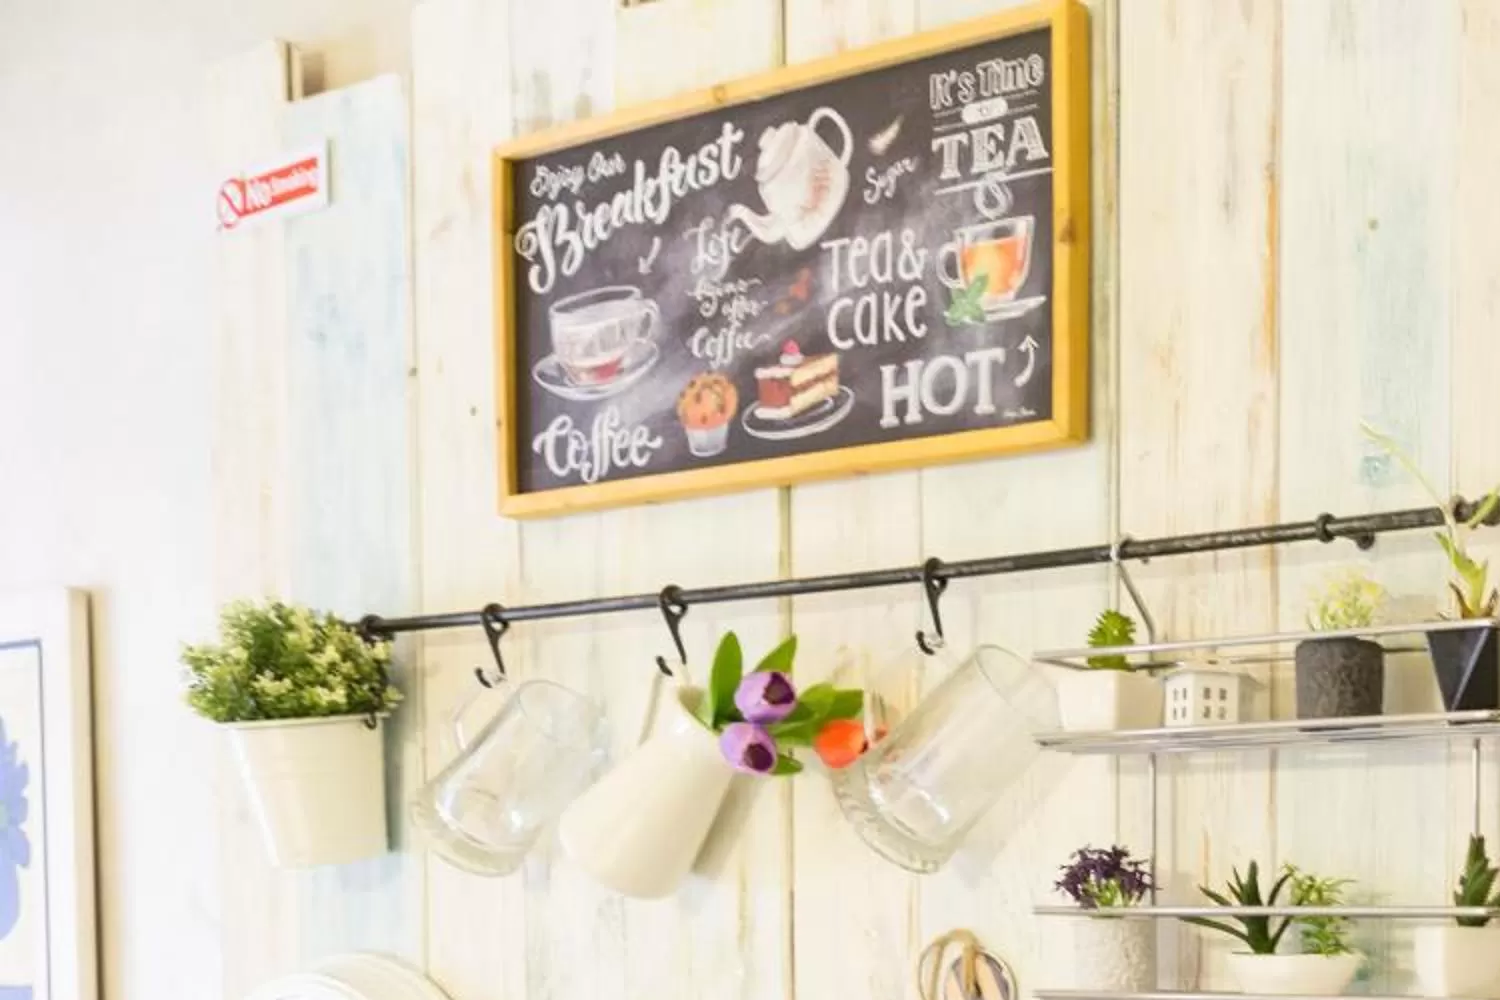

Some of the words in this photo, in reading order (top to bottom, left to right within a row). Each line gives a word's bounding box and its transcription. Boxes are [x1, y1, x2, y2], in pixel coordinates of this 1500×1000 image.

[931, 116, 1049, 180] TEA
[515, 121, 745, 295] Breakfast
[880, 347, 1006, 429] HOT
[532, 404, 664, 484] Coffee
